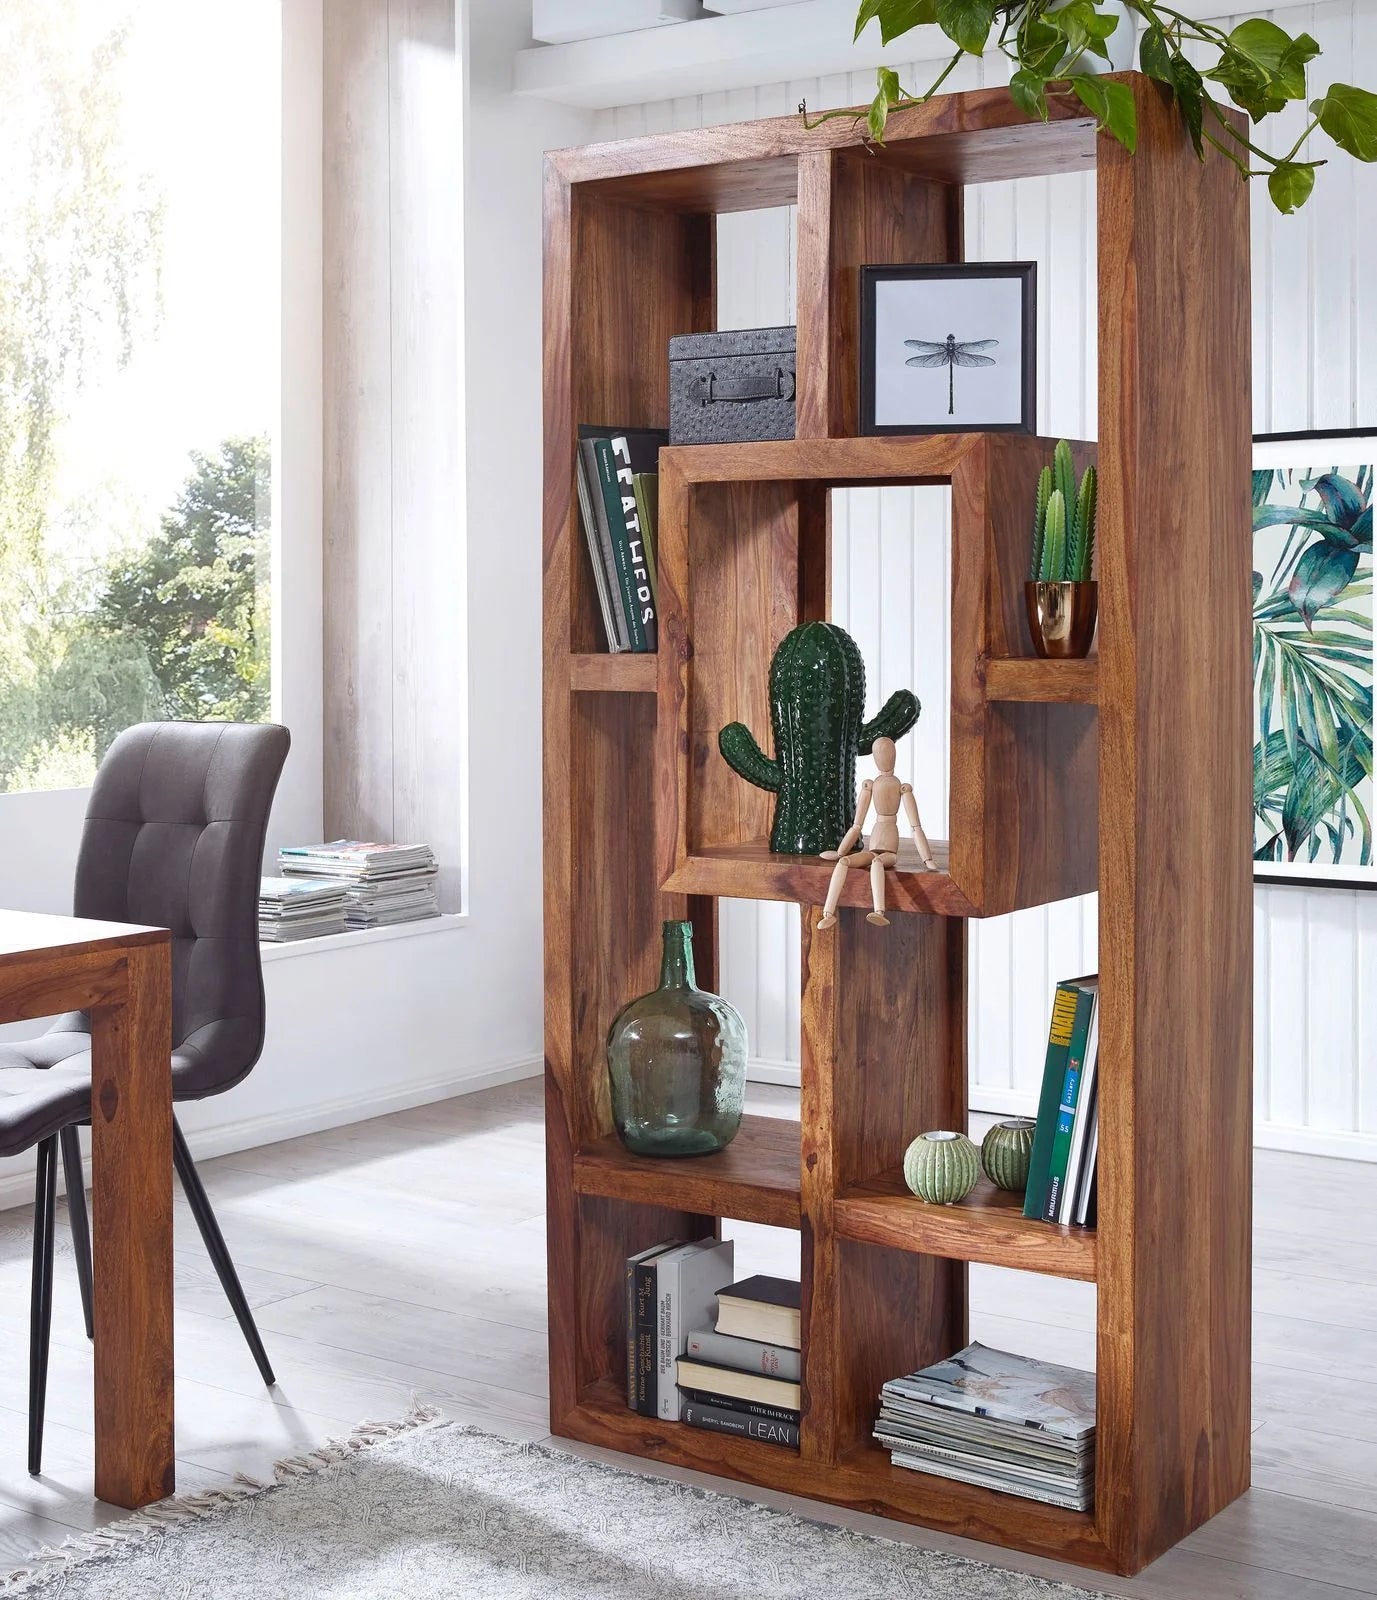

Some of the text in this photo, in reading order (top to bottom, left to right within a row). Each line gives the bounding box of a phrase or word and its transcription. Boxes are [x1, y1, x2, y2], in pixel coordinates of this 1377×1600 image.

[1066, 1078, 1075, 1104] Gallery
[644, 1276, 652, 1297] Jung
[748, 1421, 789, 1443] LEAN
